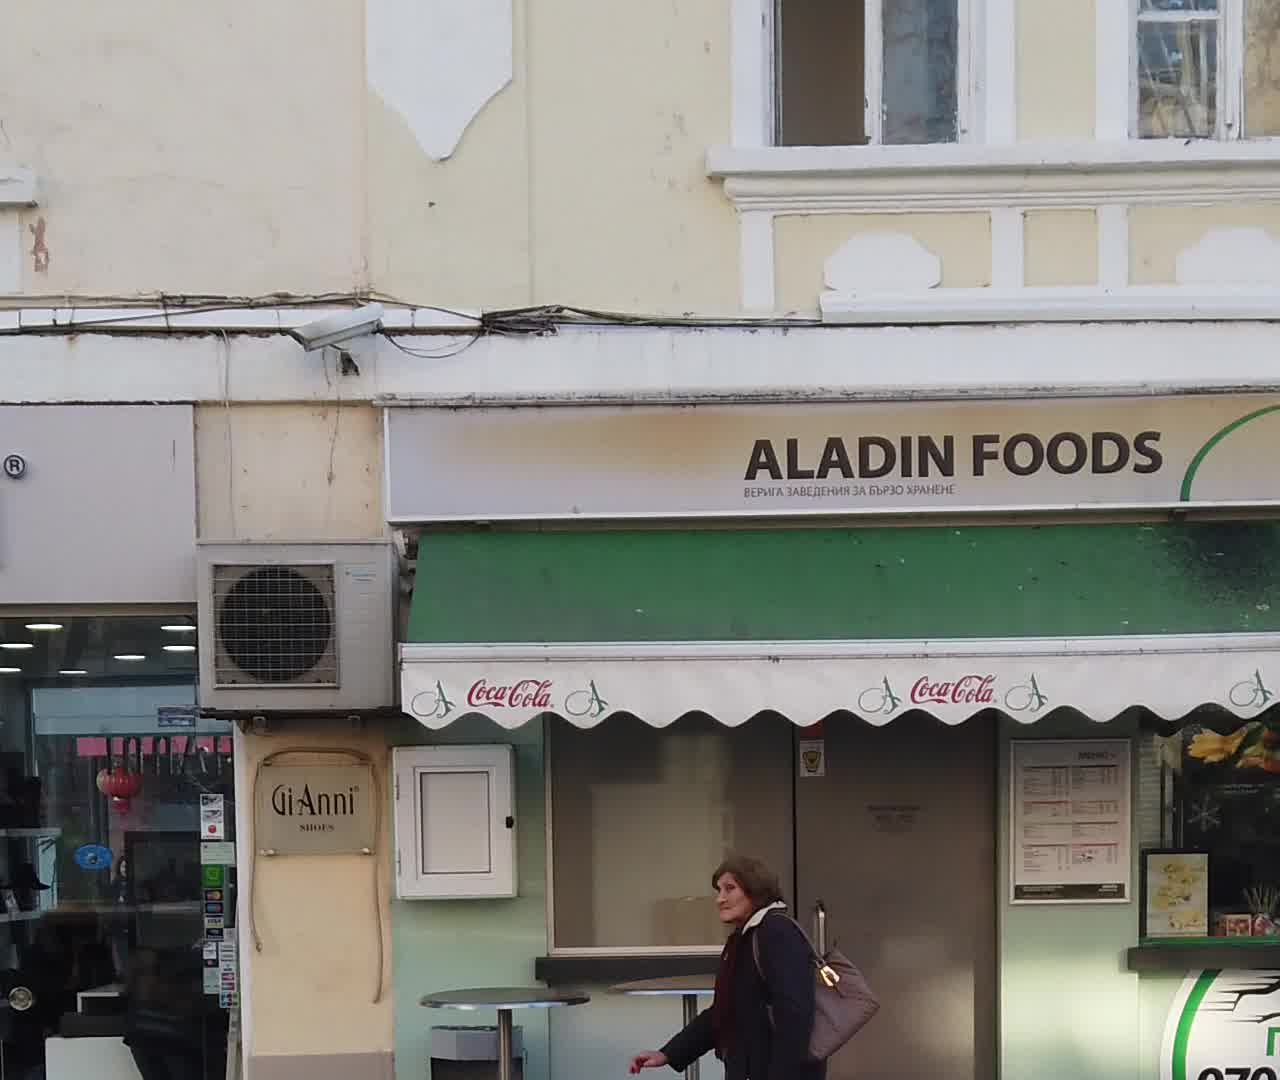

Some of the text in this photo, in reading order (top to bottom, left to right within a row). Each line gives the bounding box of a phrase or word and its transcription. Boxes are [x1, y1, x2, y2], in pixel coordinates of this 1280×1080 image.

[743, 431, 1163, 480] ALADIN FOODS
[743, 483, 955, 498] ВЕРИГА ЗАВЕДЕНИЯ ЗА БЪРЗО ХРАНЕНЕ
[467, 679, 554, 708] Coca-Cola
[910, 675, 997, 705] Coca-Cola
